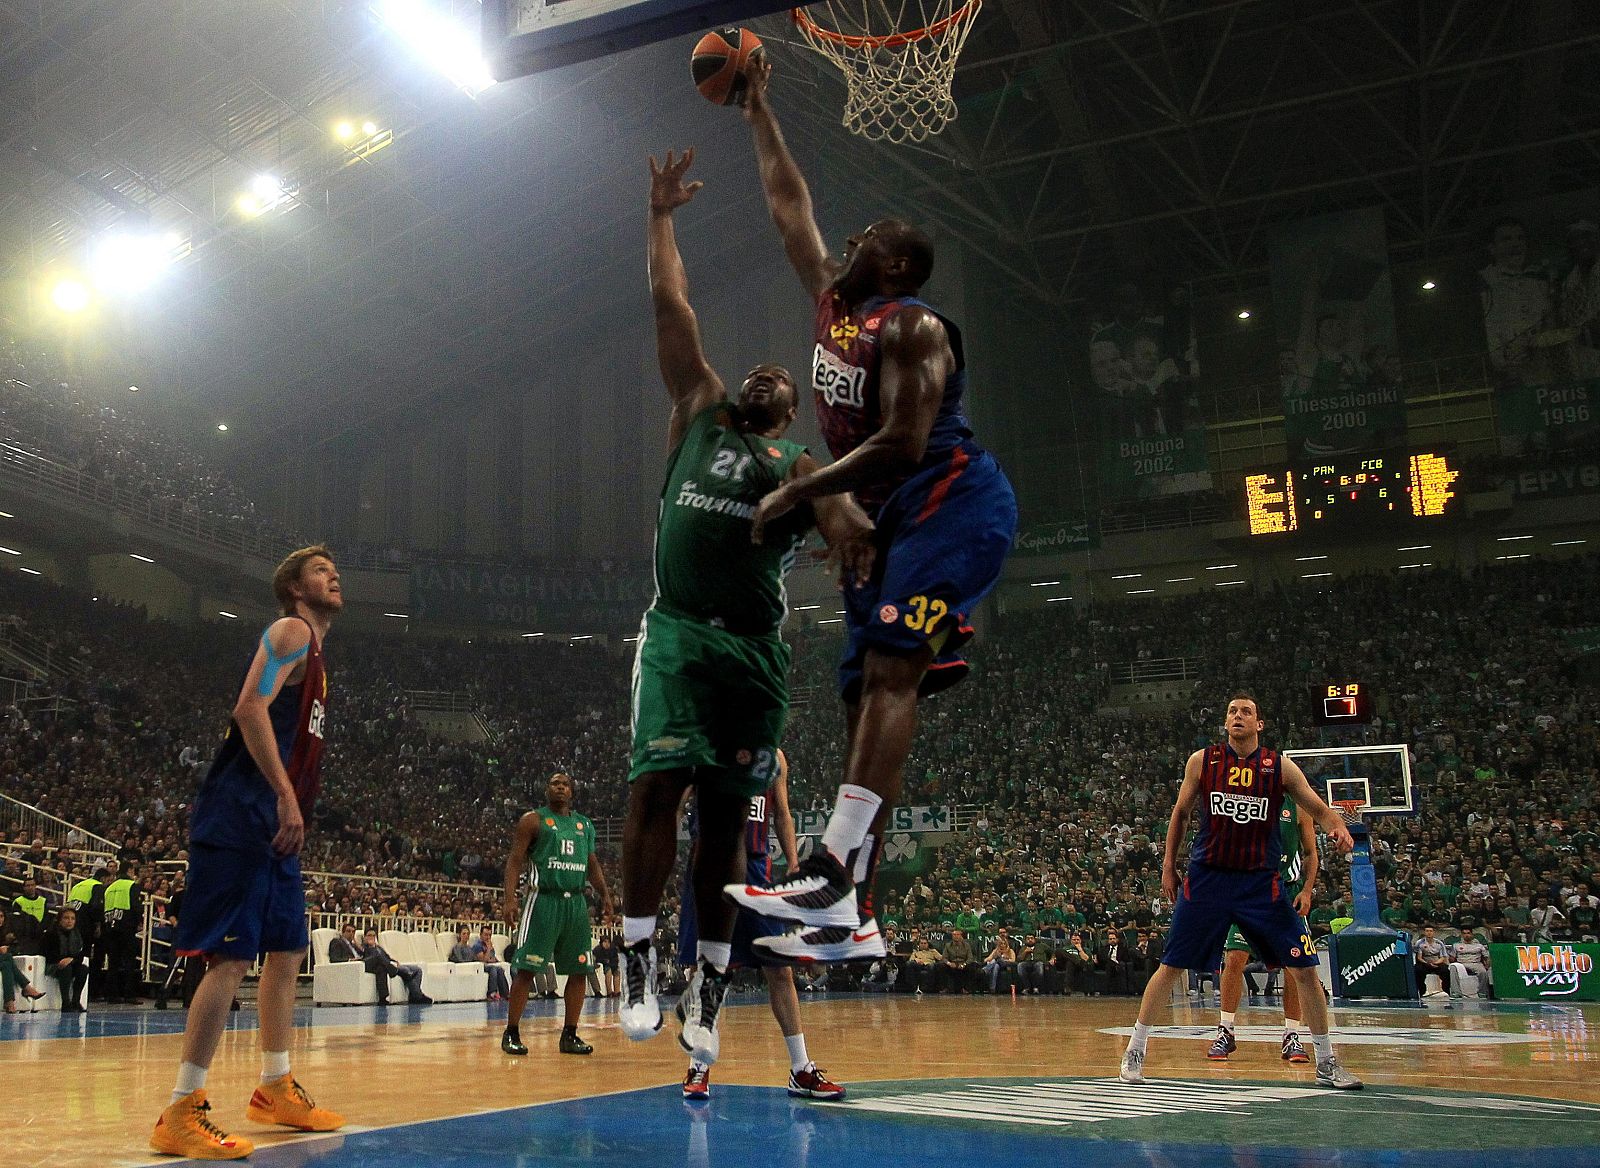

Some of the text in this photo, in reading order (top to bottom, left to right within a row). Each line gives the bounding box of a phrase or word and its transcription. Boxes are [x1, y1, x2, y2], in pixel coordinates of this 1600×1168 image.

[1287, 387, 1398, 415] Thessaloniki
[1536, 386, 1588, 405] Paris
[1322, 411, 1367, 431] 2000
[1540, 404, 1590, 426] 1996
[1120, 437, 1185, 458] Bologna
[711, 449, 753, 481] 21
[1133, 456, 1175, 476] 2002
[1313, 458, 1383, 476] PAN FCB
[1340, 473, 1367, 486] 6:19
[1327, 494, 1335, 505] 5
[1379, 488, 1387, 498] 6
[904, 595, 948, 635] 32
[1327, 684, 1359, 698] 6:19
[1228, 766, 1253, 788] 20
[1210, 792, 1269, 823] Regal
[560, 839, 575, 856] 15
[1515, 945, 1593, 975] Molto
[1521, 970, 1580, 996] way
